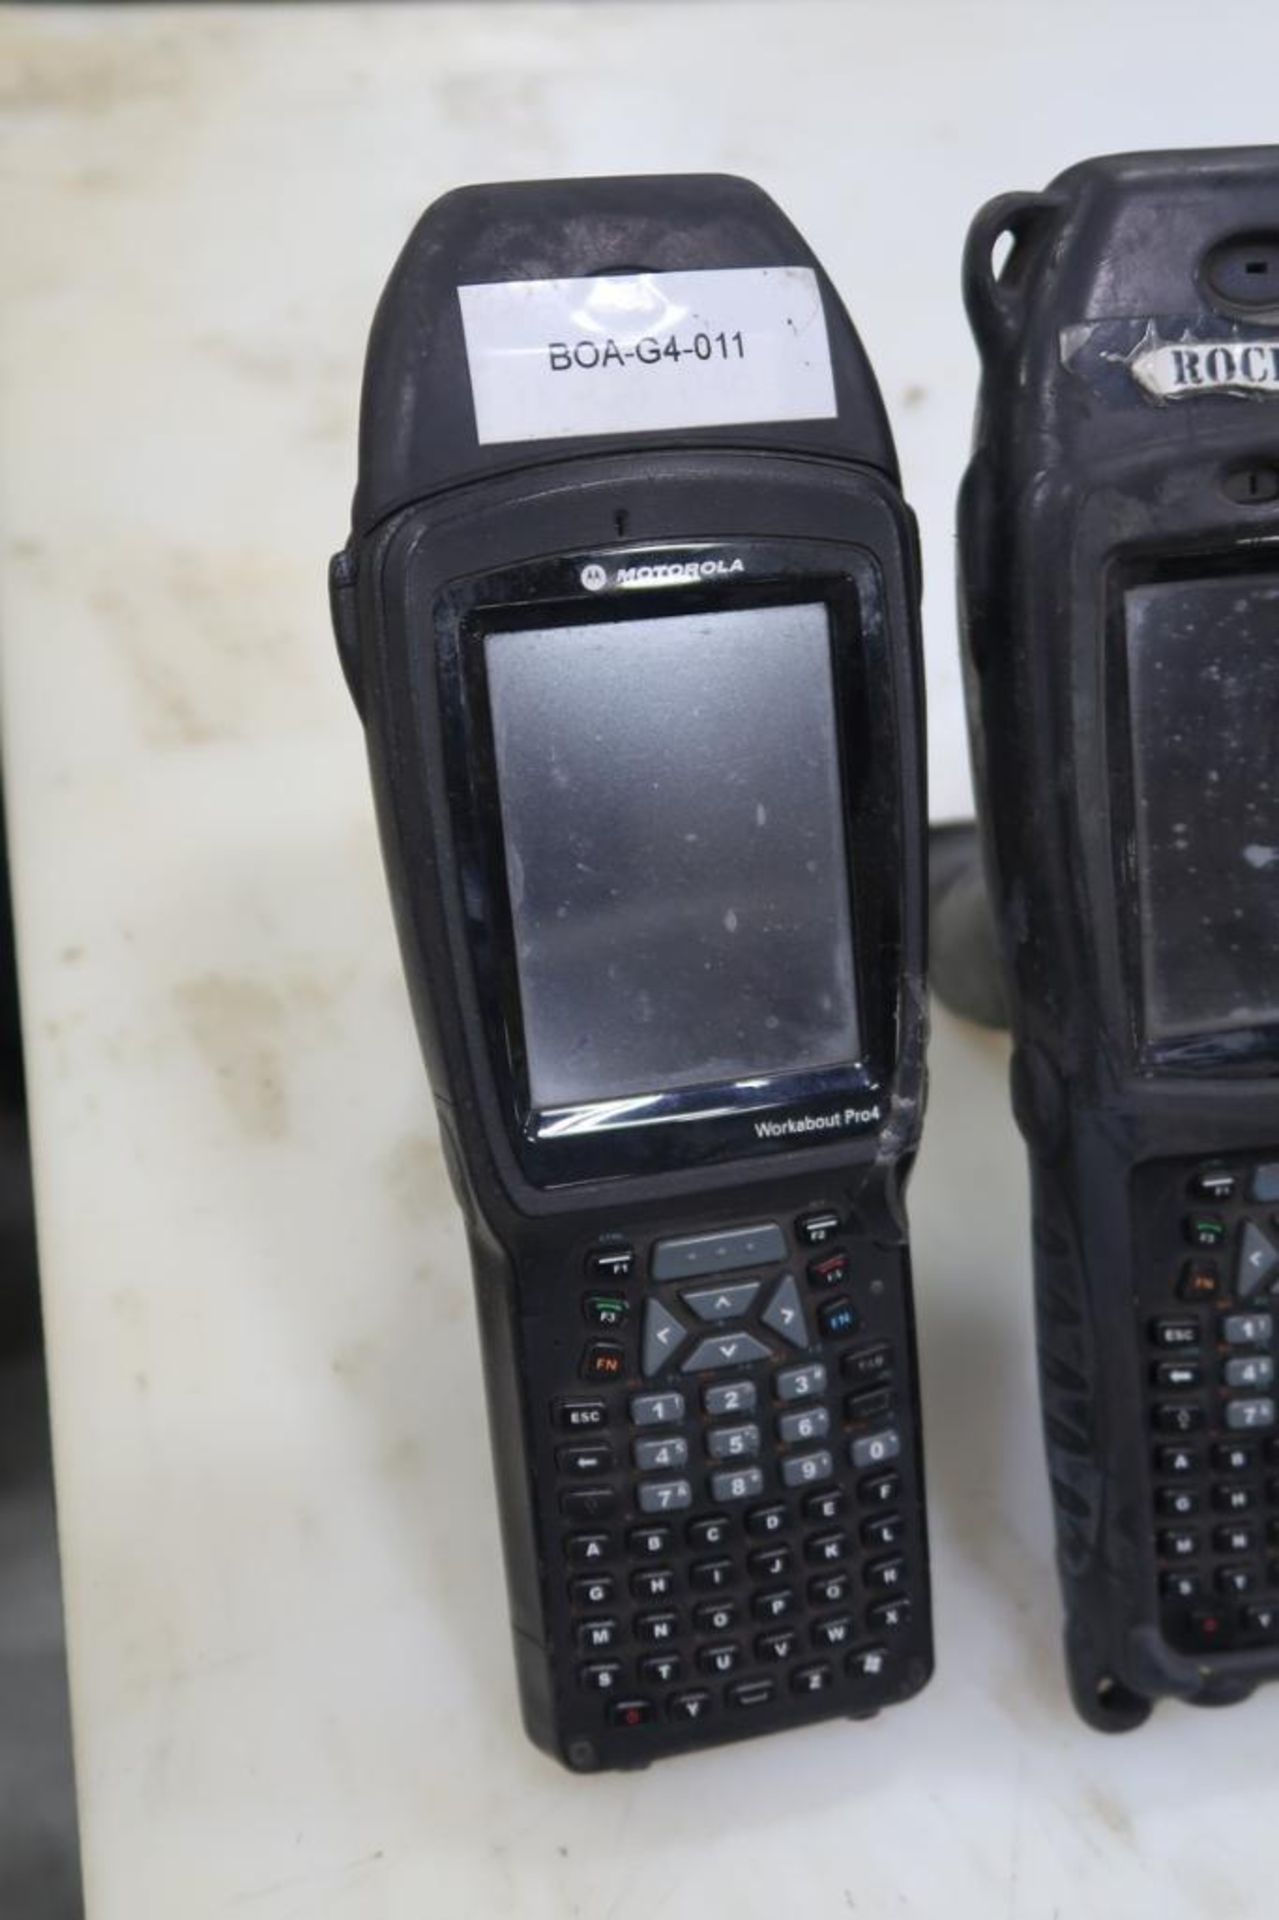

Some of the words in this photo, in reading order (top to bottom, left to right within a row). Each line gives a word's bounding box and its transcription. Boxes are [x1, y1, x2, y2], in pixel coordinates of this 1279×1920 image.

[548, 331, 745, 371] BOA-G4-011
[616, 558, 745, 585] MOTOROLA
[754, 1112, 841, 1138] Workabout
[844, 1105, 880, 1124] Pro4
[596, 1358, 619, 1372] FN
[570, 1410, 601, 1424] ESC
[880, 1484, 892, 1499] F
[823, 1502, 836, 1517] E
[766, 1515, 779, 1530] D
[706, 1528, 720, 1542] C
[882, 1528, 894, 1542] L
[586, 1543, 601, 1557] A
[648, 1536, 662, 1551] B
[825, 1543, 839, 1558] K
[770, 1559, 782, 1573] J
[651, 1579, 665, 1593] H
[589, 1587, 605, 1602] G
[772, 1600, 785, 1615] P
[713, 1613, 728, 1628] O
[593, 1630, 610, 1645] M
[654, 1624, 668, 1638] N
[827, 1626, 845, 1641] W
[774, 1642, 788, 1657] V
[716, 1655, 732, 1670] U
[659, 1664, 671, 1680] T
[598, 1672, 611, 1688] S
[686, 1702, 699, 1717] Y
